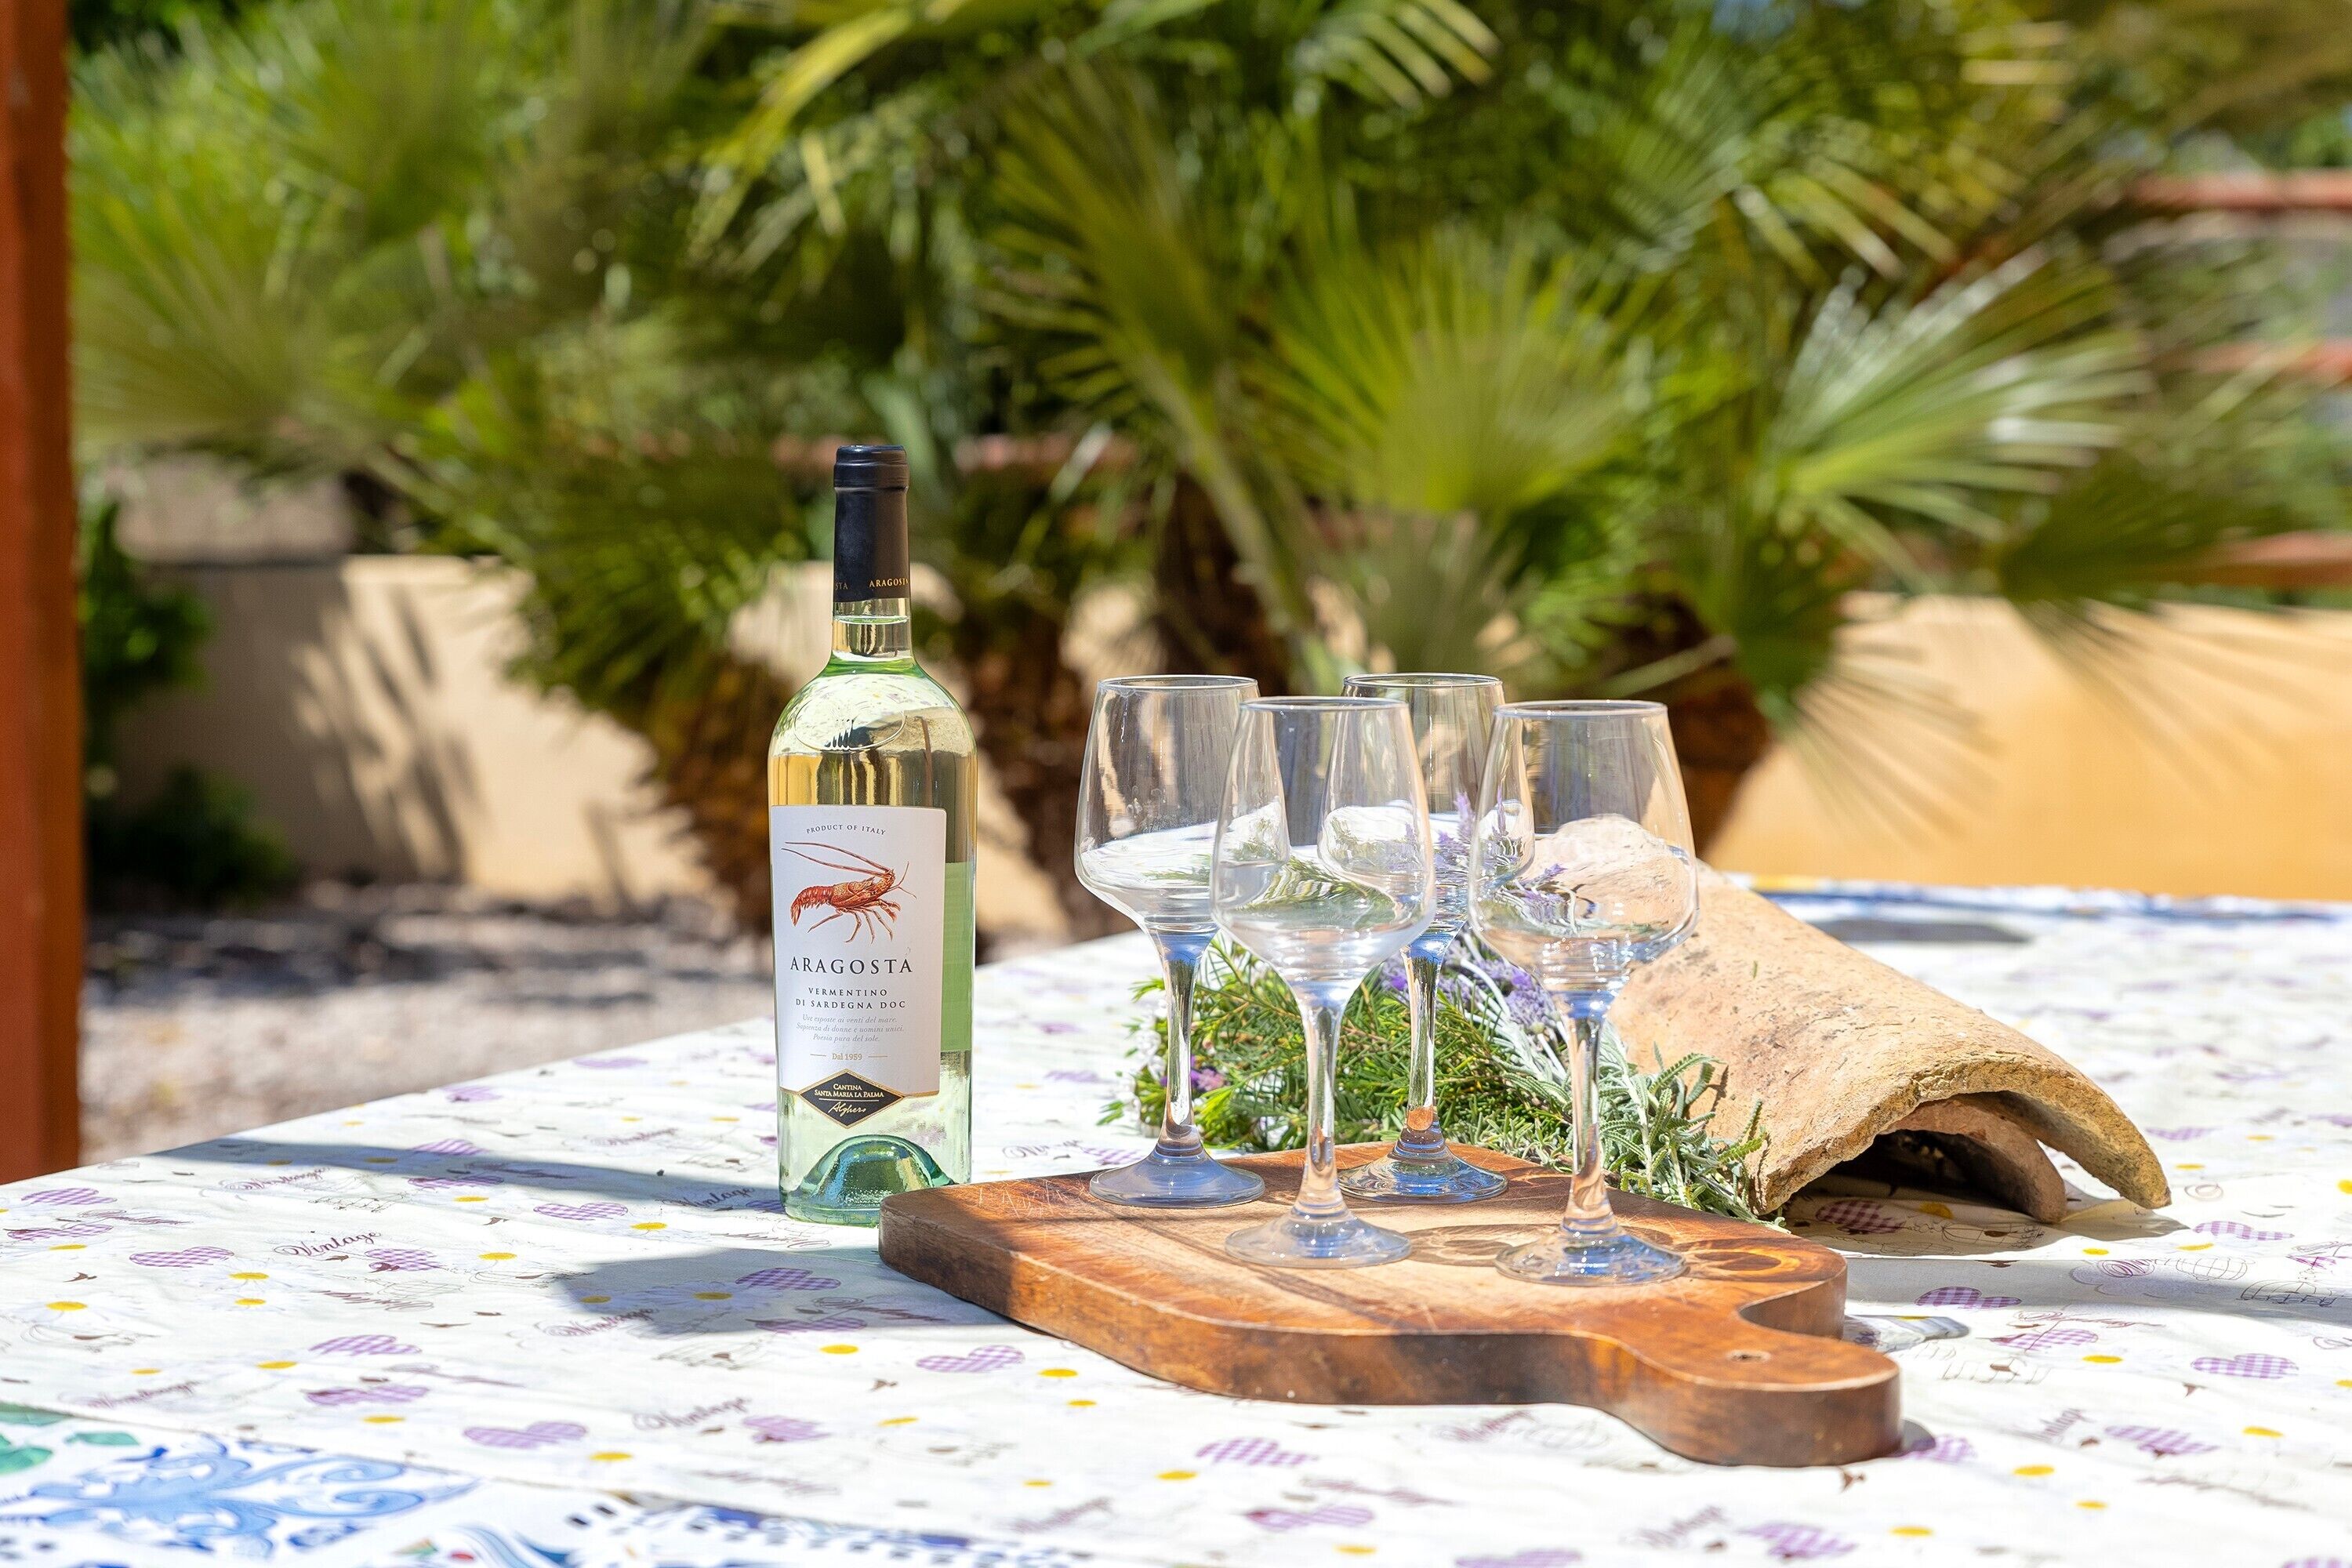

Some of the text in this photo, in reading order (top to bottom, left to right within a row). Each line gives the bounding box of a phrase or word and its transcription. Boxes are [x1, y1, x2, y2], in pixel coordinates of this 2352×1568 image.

[806, 824, 843, 834] PRODUCT
[862, 826, 886, 836] ITALY
[789, 956, 913, 975] ARAGOSTA
[808, 987, 887, 996] VERMENTINO
[796, 998, 906, 1010] DI SARDEGNA DOC
[796, 1022, 822, 1032] Sapienza
[828, 1101, 866, 1117] Alghero
[274, 1231, 382, 1257] Vintage
